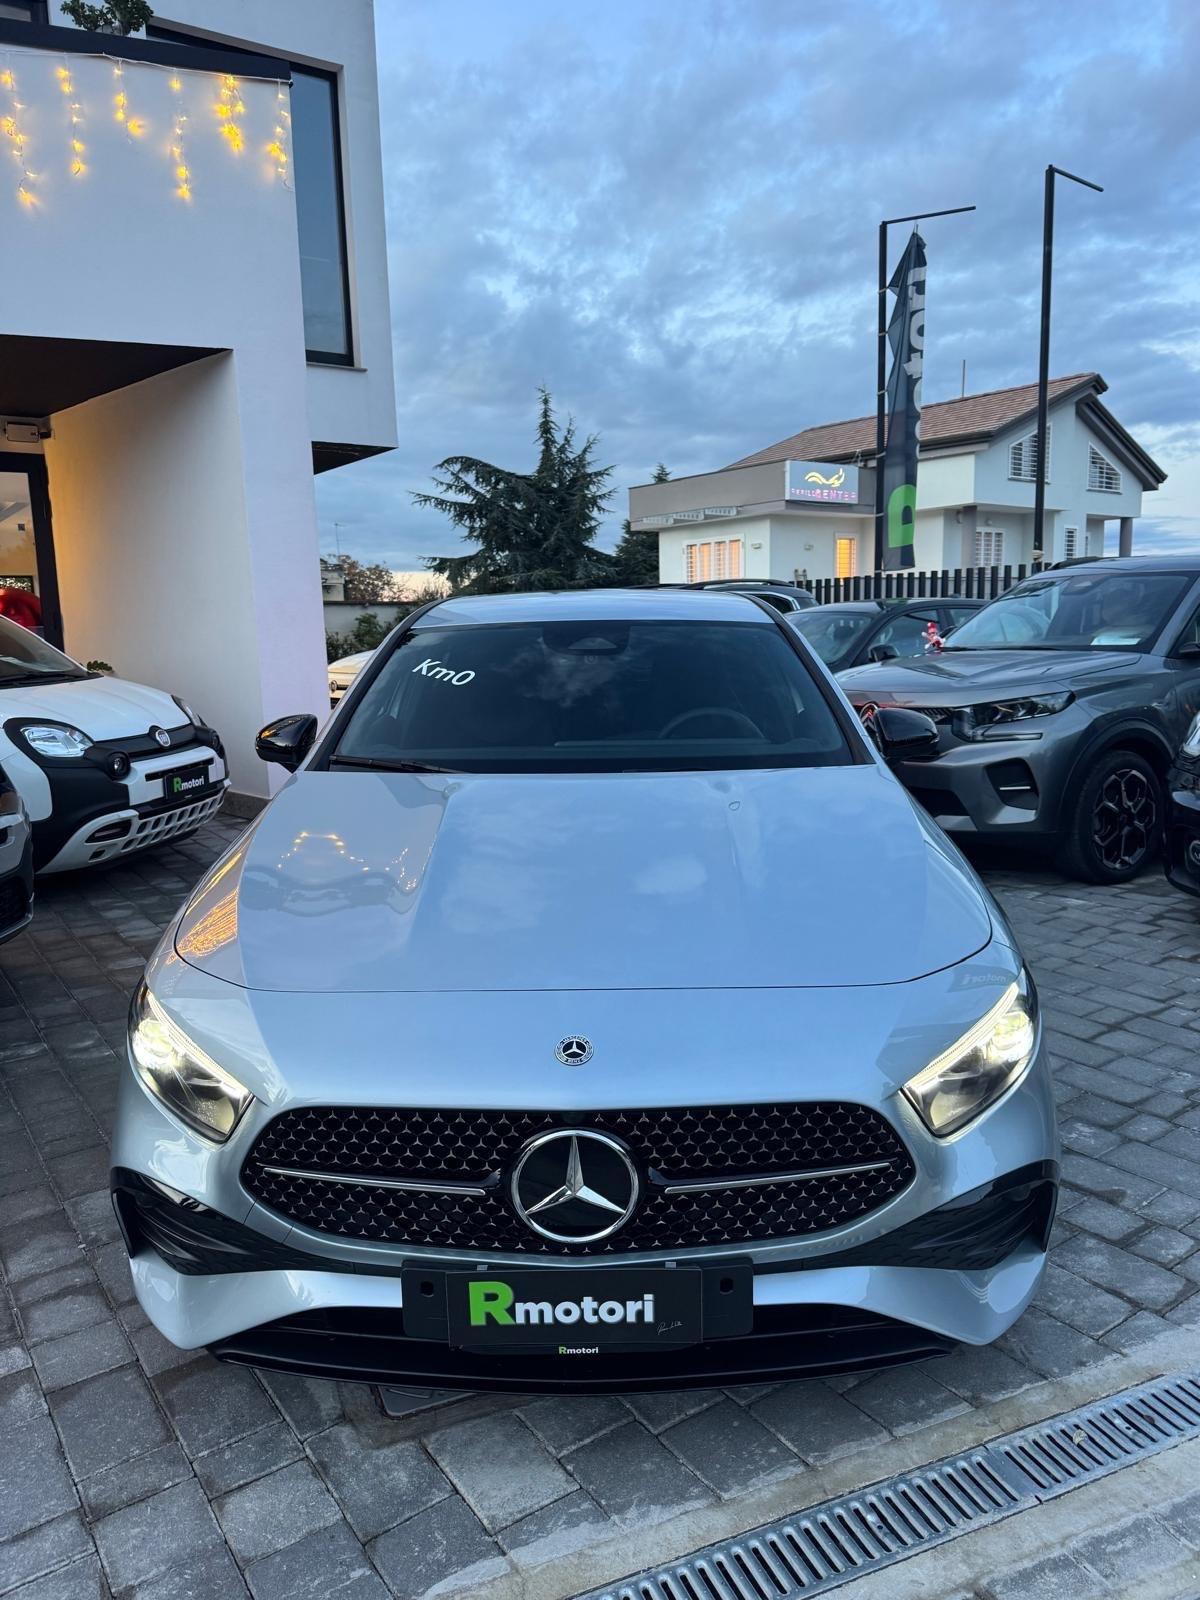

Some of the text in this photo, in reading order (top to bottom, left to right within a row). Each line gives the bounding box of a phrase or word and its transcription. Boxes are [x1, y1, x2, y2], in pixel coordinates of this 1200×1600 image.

[174, 776, 204, 792] Rmotori
[468, 1281, 654, 1326] Rmotori
[558, 1345, 600, 1355] Rmotori
